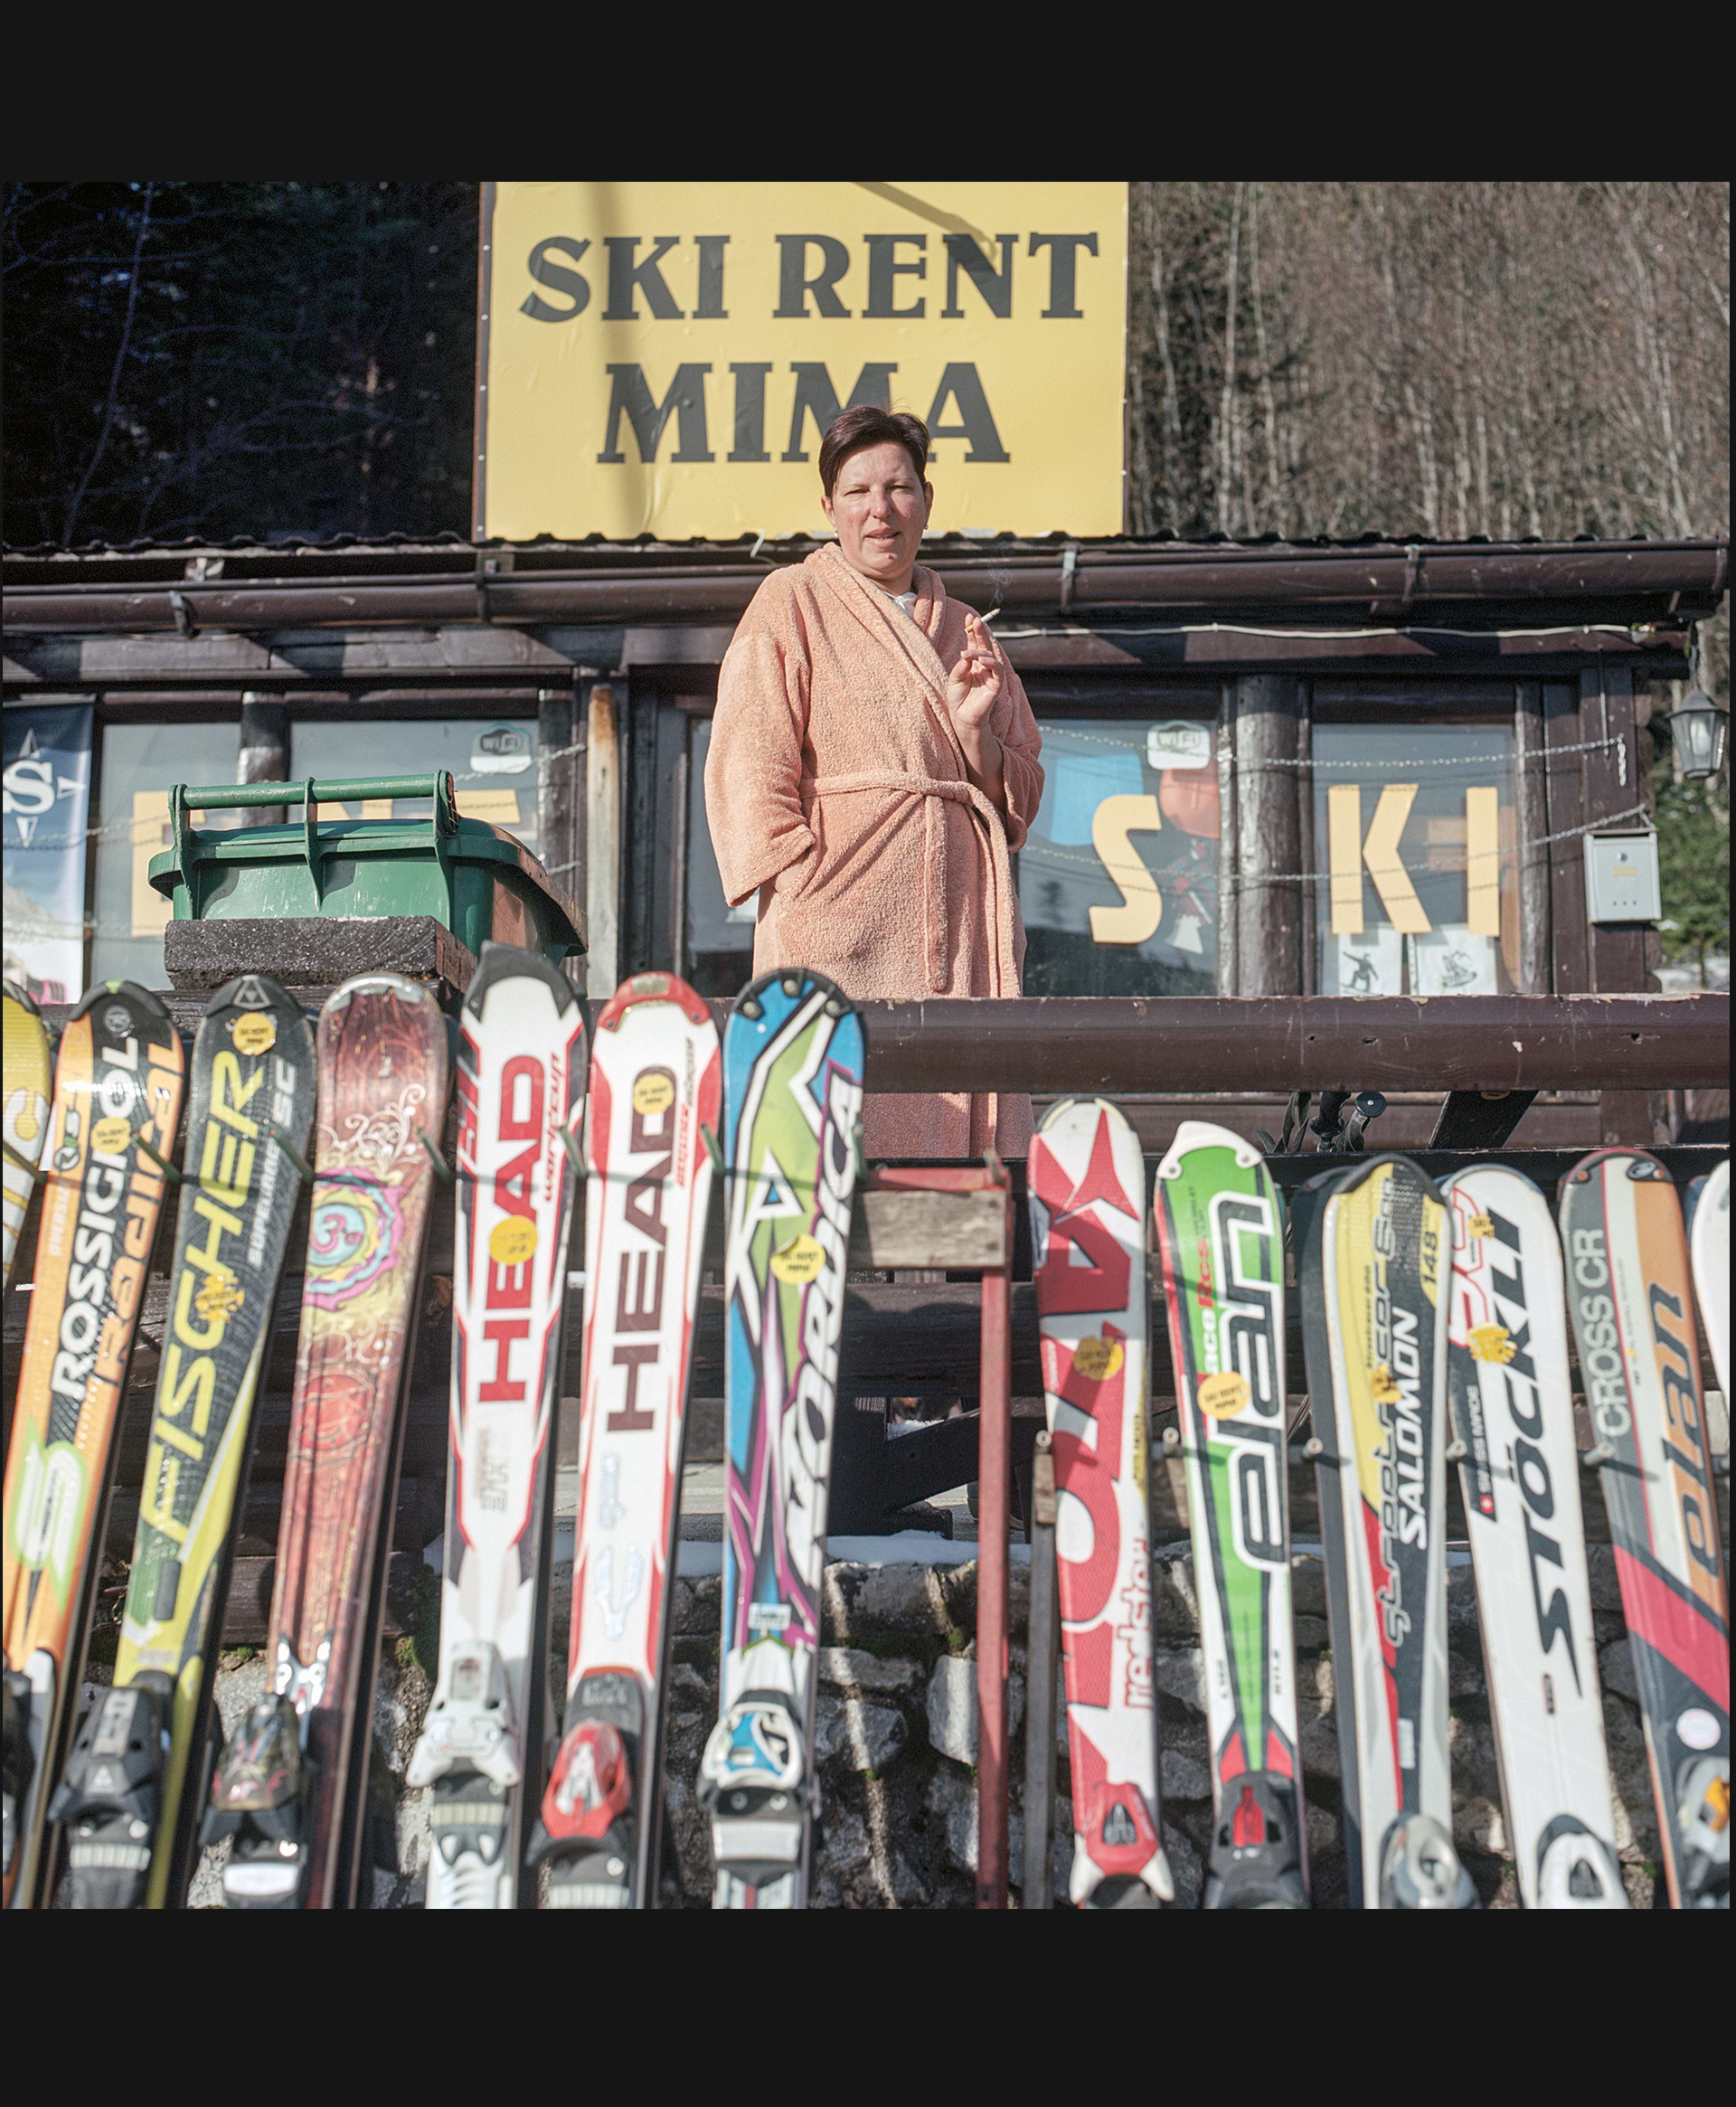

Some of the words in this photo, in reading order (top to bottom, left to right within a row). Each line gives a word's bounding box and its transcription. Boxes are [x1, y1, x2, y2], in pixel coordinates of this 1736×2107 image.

[519, 234, 731, 323] SKI
[773, 231, 1099, 320] RENT
[597, 362, 1012, 464] MIMA
[3, 761, 55, 814] S
[273, 1053, 298, 1129] SC
[478, 1055, 545, 1403] HEAD
[607, 1065, 678, 1432] HEAD
[1422, 1228, 1438, 1287] 148
[1572, 1228, 1609, 1289] CR
[141, 1049, 265, 1545] FISCHER
[782, 1072, 863, 1591] NORDICA
[1210, 1192, 1287, 1570] elan
[1466, 1384, 1483, 1439] MADE
[1578, 1297, 1631, 1437] CROSS
[1391, 1306, 1428, 1552] SALOMON
[1475, 1441, 1490, 1493] SWISS
[1648, 1281, 1720, 1580] elan
